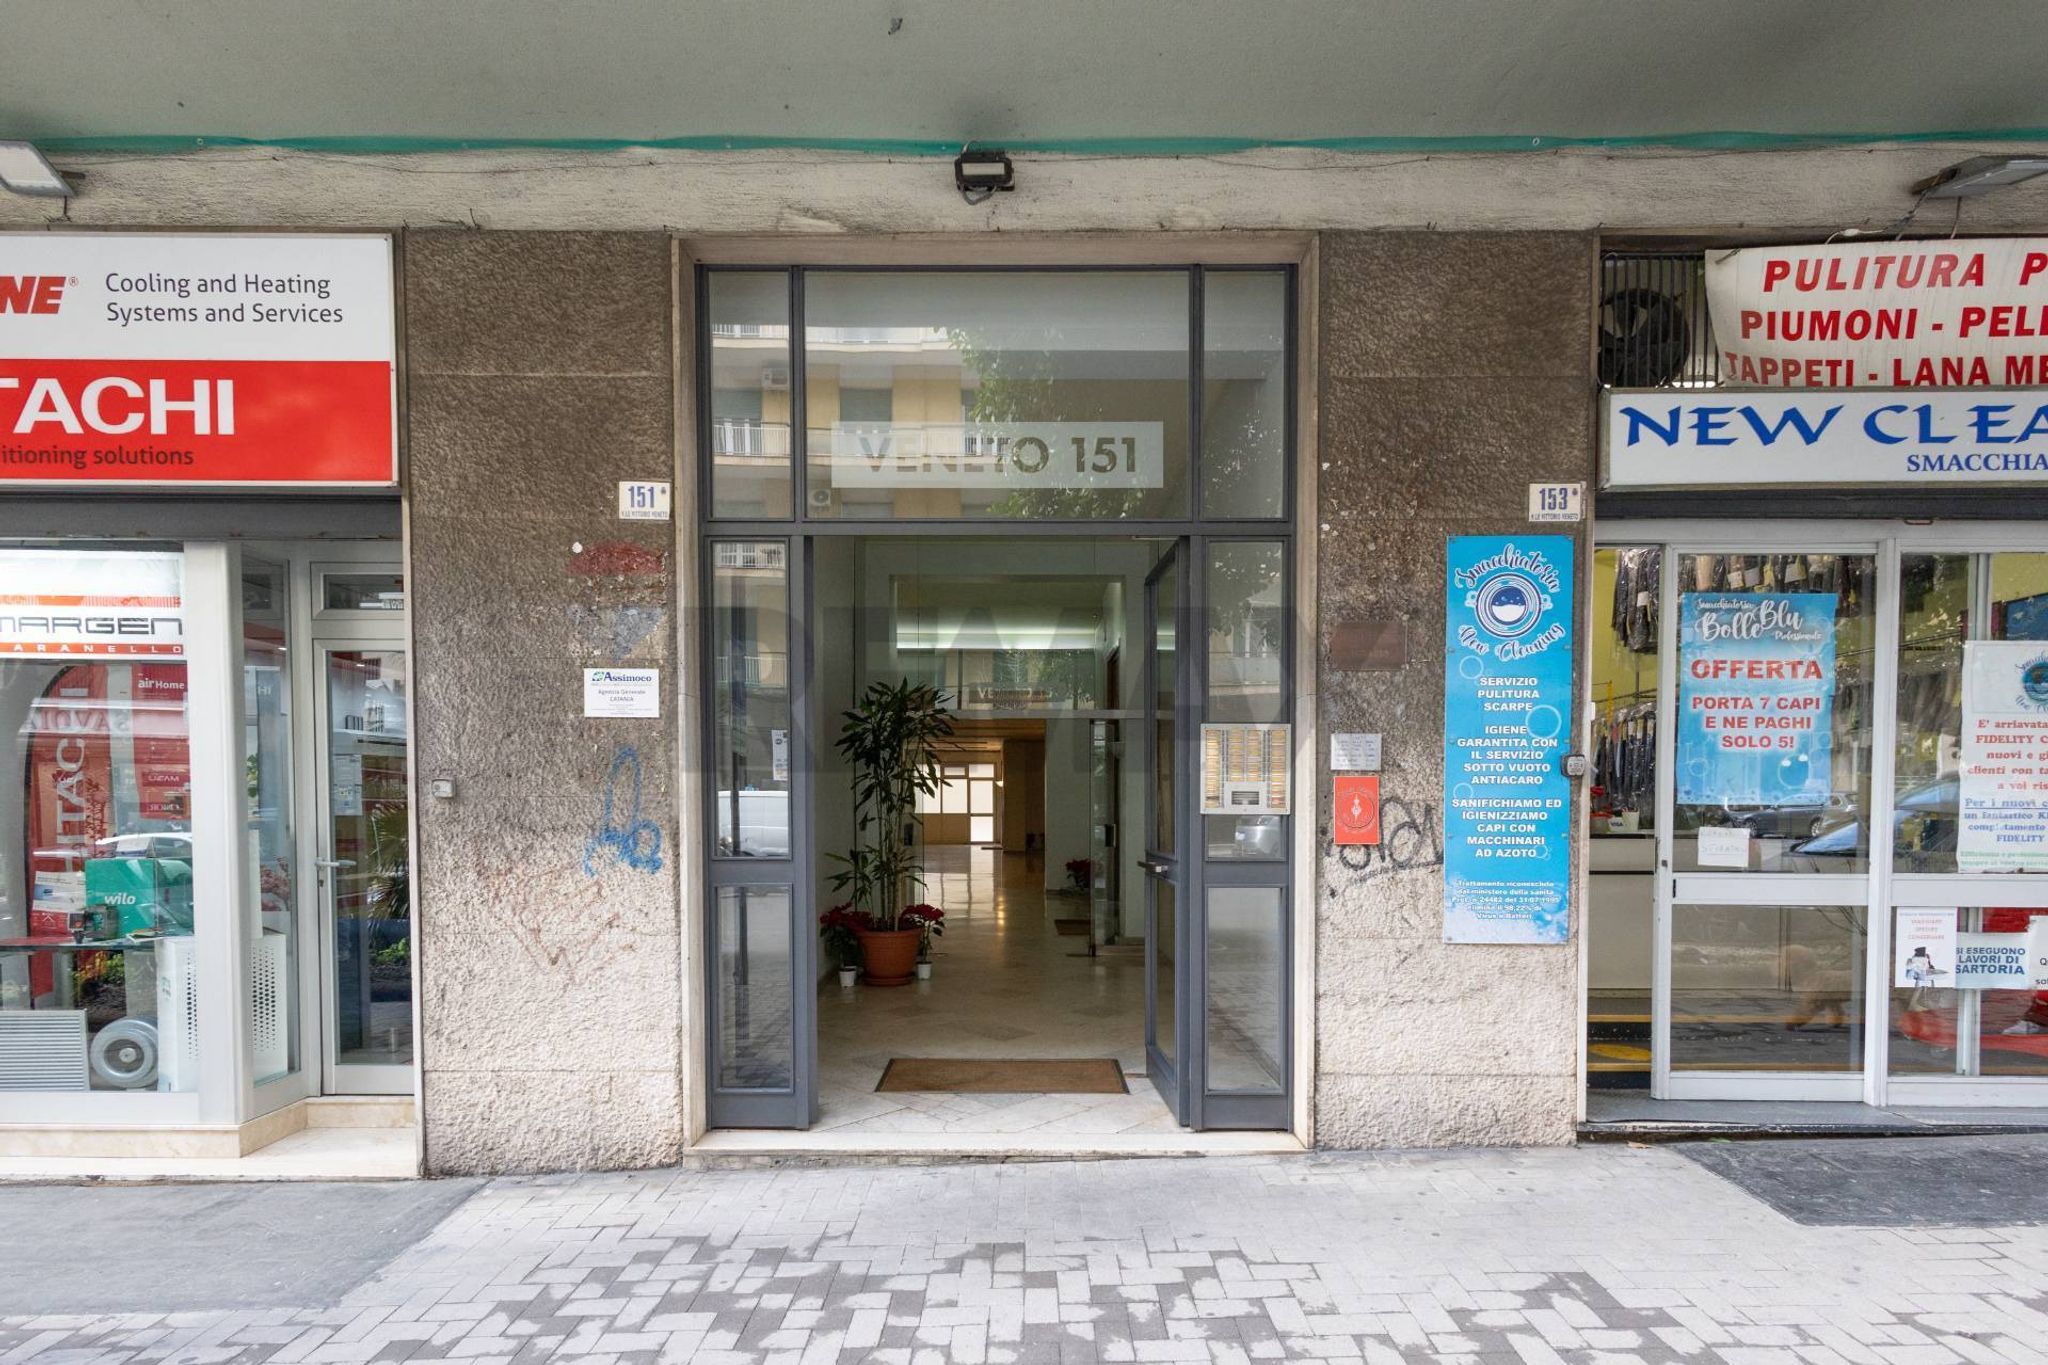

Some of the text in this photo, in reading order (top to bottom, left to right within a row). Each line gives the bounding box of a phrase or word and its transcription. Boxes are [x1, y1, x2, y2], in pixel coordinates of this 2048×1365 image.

[1763, 253, 1985, 293] PULITURA
[105, 273, 330, 299] Cooling and Heating
[107, 302, 343, 327] Systems and Services
[1740, 308, 1918, 342] PIUMONI
[1724, 352, 1855, 387] TAPPETI
[1893, 356, 1991, 387] LANA
[1619, 404, 1844, 447] NEW
[2, 445, 194, 470] itioning solutions
[858, 437, 1136, 473] VENETO 151
[1906, 453, 2048, 473] SMACCHIA
[628, 486, 655, 508] 151
[1539, 488, 1568, 510] 153
[1691, 658, 1823, 680] OFFERTA
[604, 672, 652, 682] Assimoco
[1480, 677, 1537, 686] SERVIZIO
[1477, 690, 1540, 699] PULITURA
[1484, 702, 1533, 711] SCARPE
[1692, 697, 1821, 710] PORTA 7 CAPI
[1705, 716, 1812, 729] E NE PAGHI
[1485, 725, 1527, 734] IGIENE
[1457, 738, 1558, 747] GARANTITA CON
[1722, 735, 1795, 748] SOLO 5!
[1975, 735, 2034, 744] FIDELITY
[1471, 751, 1544, 760] IL SERVIZIO
[1986, 750, 2022, 760] nuovi
[1464, 763, 1551, 772] SOTTO VUOTO
[1967, 766, 2006, 775] clienti
[1471, 775, 1543, 785] ANTIACARO
[1452, 799, 1562, 808] SANIFICHIAMO ED
[1965, 798, 1986, 808] Per
[2002, 798, 2036, 808] nuovi
[1462, 811, 1548, 820] IGIENIZZIAMO
[1477, 823, 1536, 832] CAPI CON
[1467, 836, 1545, 845] MACCHINARI
[1996, 834, 2044, 843] FIDELITY
[1475, 849, 1537, 858] AD AZOTO
[104, 892, 136, 905] wilo
[1967, 947, 2026, 956] ESEGUONO
[1959, 955, 2018, 964] LAVORI DI
[1955, 965, 2025, 975] SARTORIA
